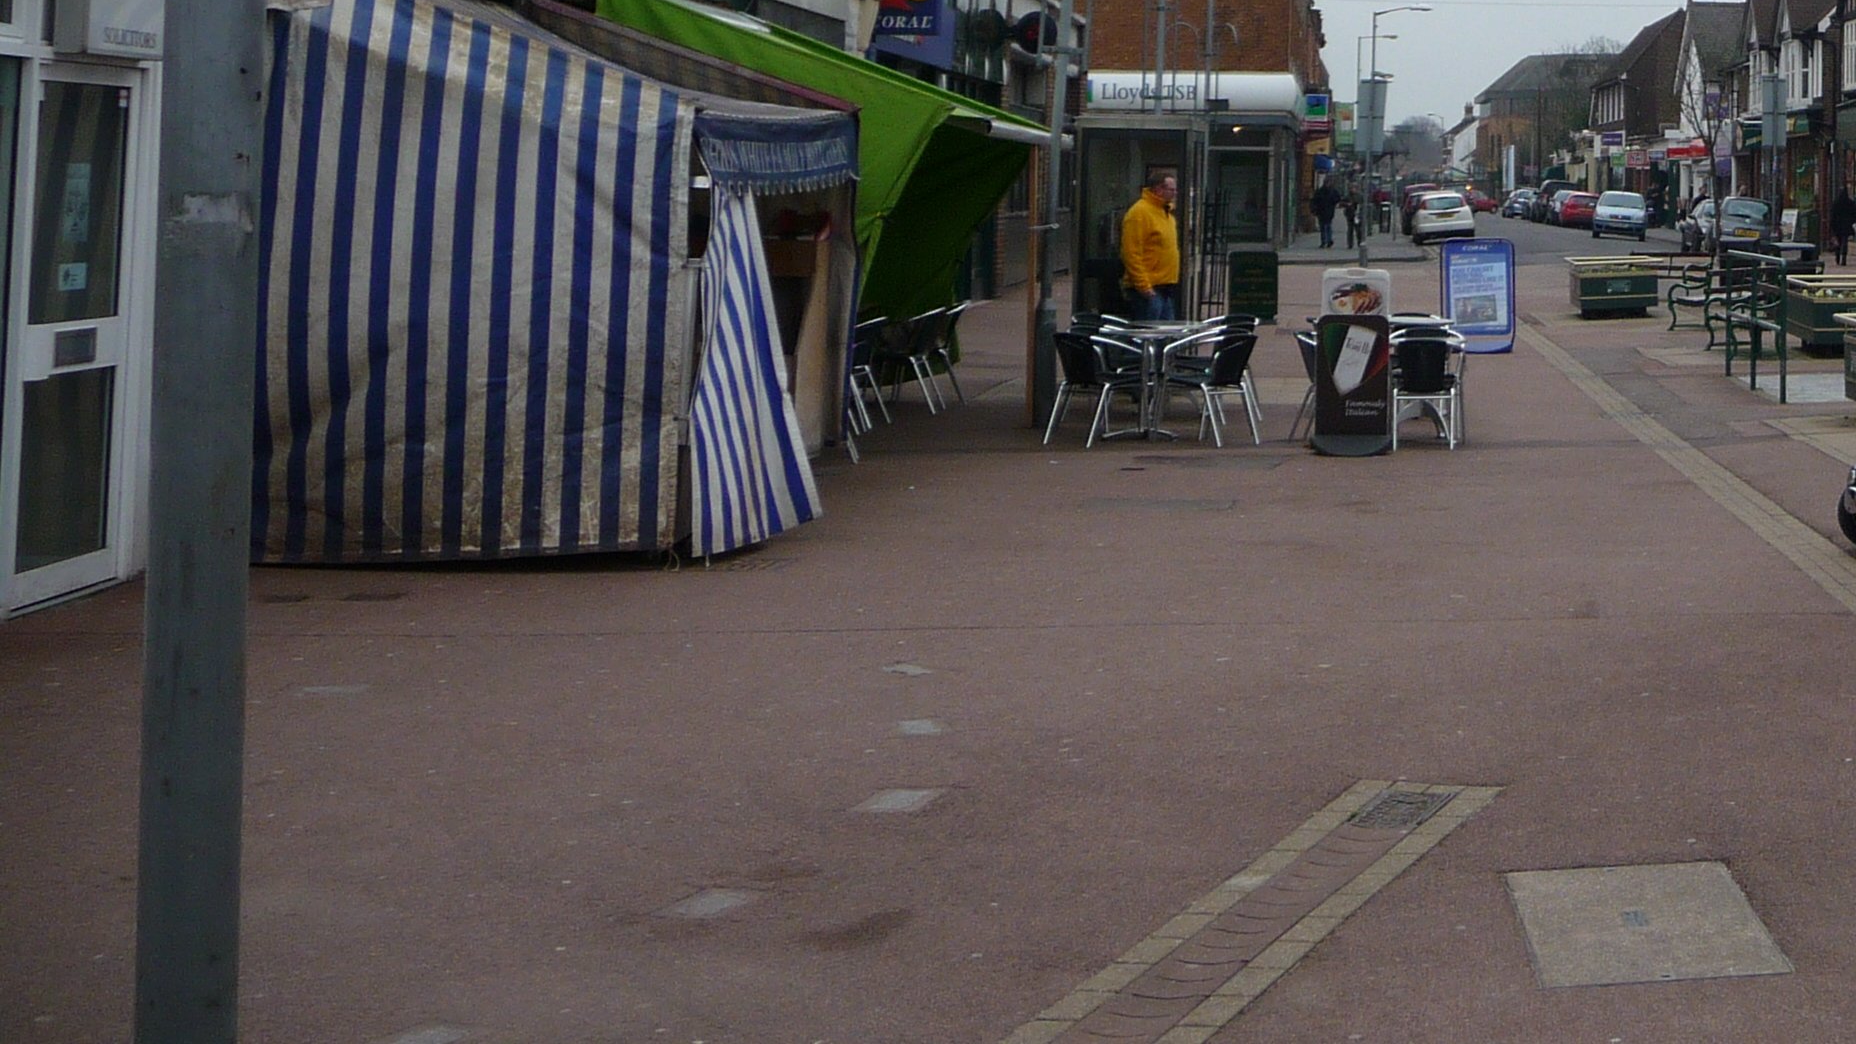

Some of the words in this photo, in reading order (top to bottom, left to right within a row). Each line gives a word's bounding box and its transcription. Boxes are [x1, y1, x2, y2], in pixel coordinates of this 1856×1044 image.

[103, 26, 157, 49] SOLICITORS
[1102, 83, 1158, 104] Lloyds
[1162, 84, 1198, 101] TSB
